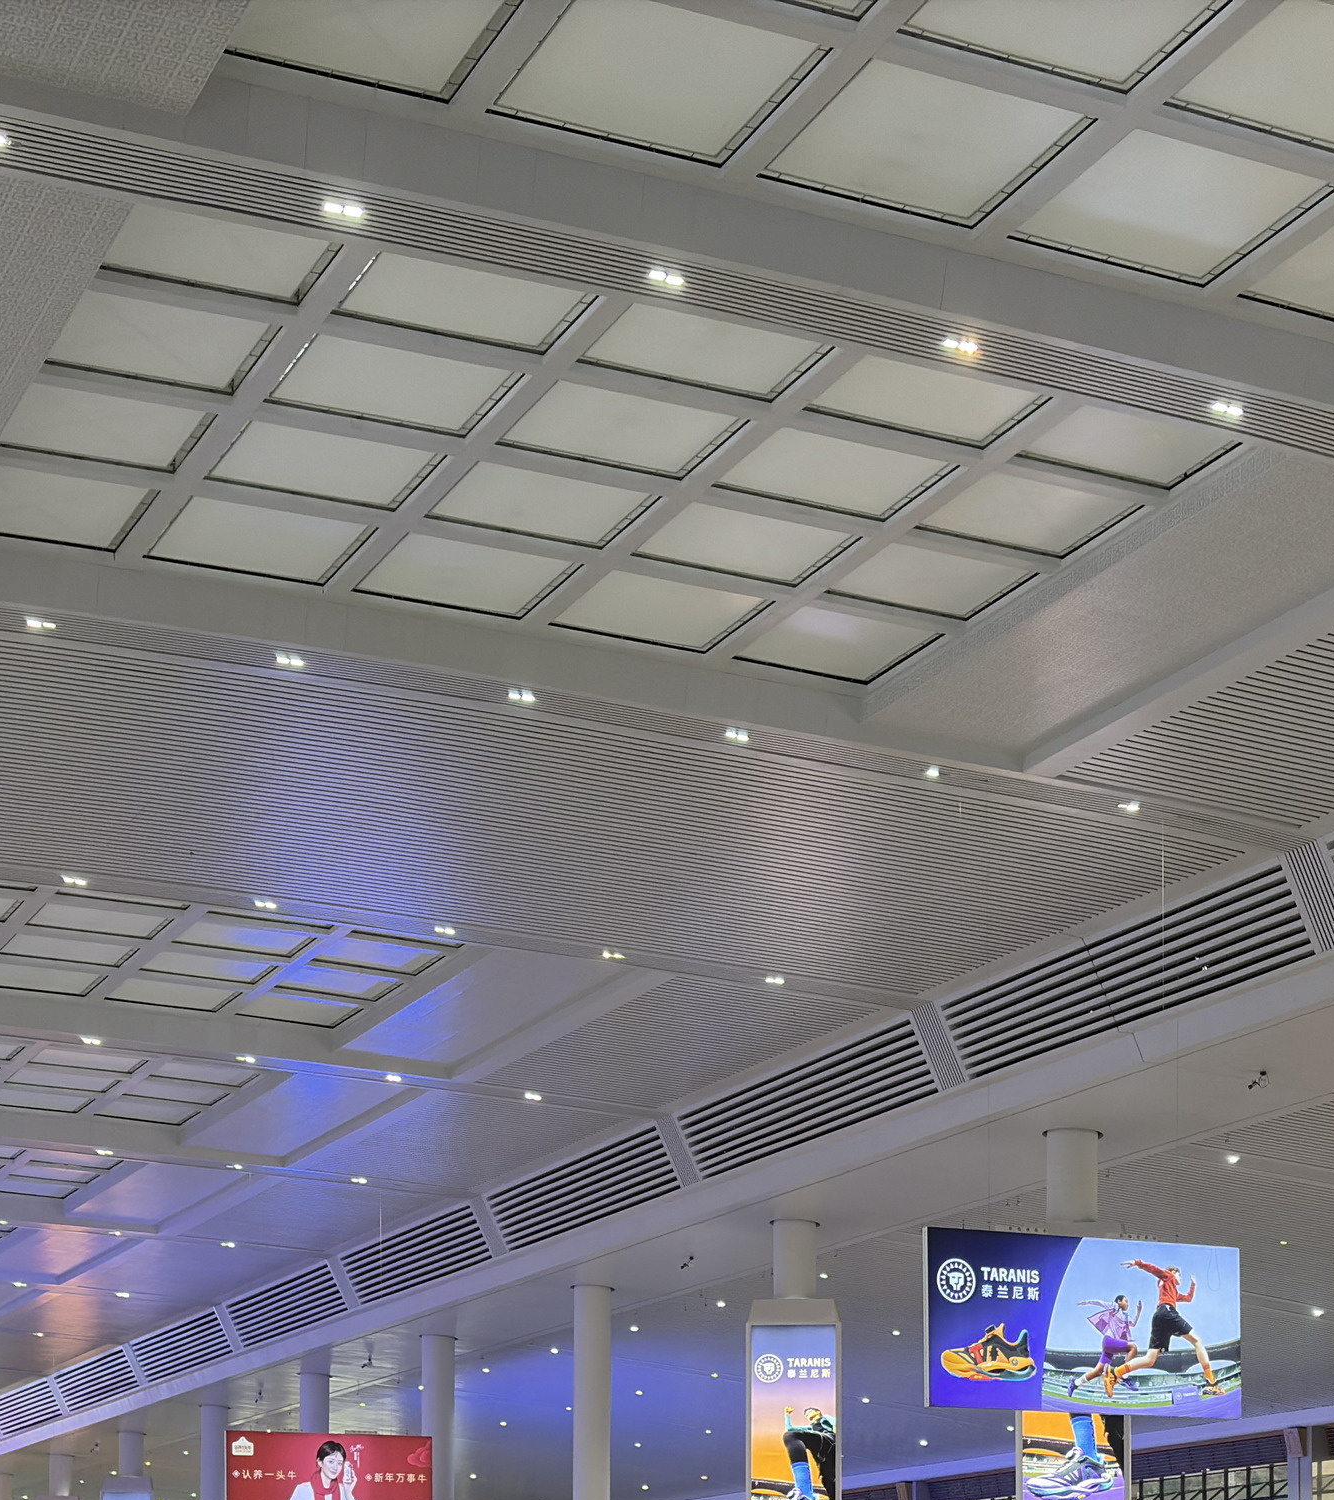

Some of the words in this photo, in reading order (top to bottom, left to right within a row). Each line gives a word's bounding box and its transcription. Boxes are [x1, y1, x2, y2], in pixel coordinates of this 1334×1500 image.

[980, 1266, 1040, 1284] TARANIS
[981, 1284, 1040, 1301] 泰兰尼斯
[787, 1357, 832, 1367] TARANIS
[242, 1469, 297, 1480] 认养一头牛
[374, 1472, 428, 1483] 新年万事牛
